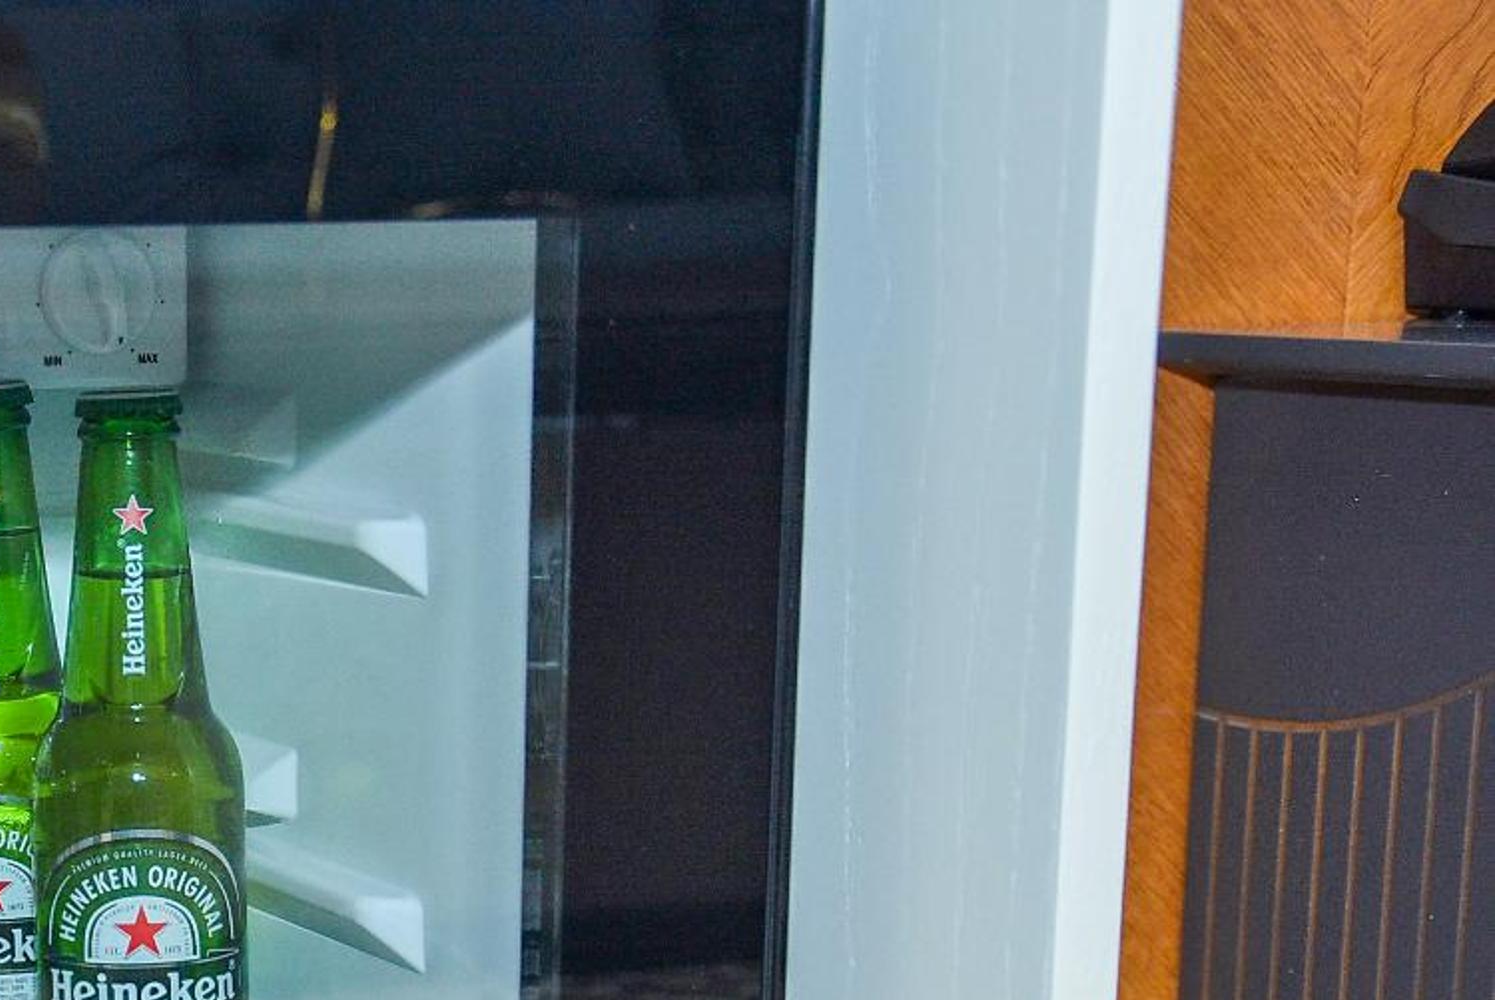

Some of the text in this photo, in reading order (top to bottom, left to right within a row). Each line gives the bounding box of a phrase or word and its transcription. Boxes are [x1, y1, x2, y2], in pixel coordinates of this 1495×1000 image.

[44, 356, 62, 366] MIN
[138, 353, 158, 364] MAX
[121, 543, 145, 676] Heineken
[59, 864, 224, 942] HEINEKEN ORIGINAL
